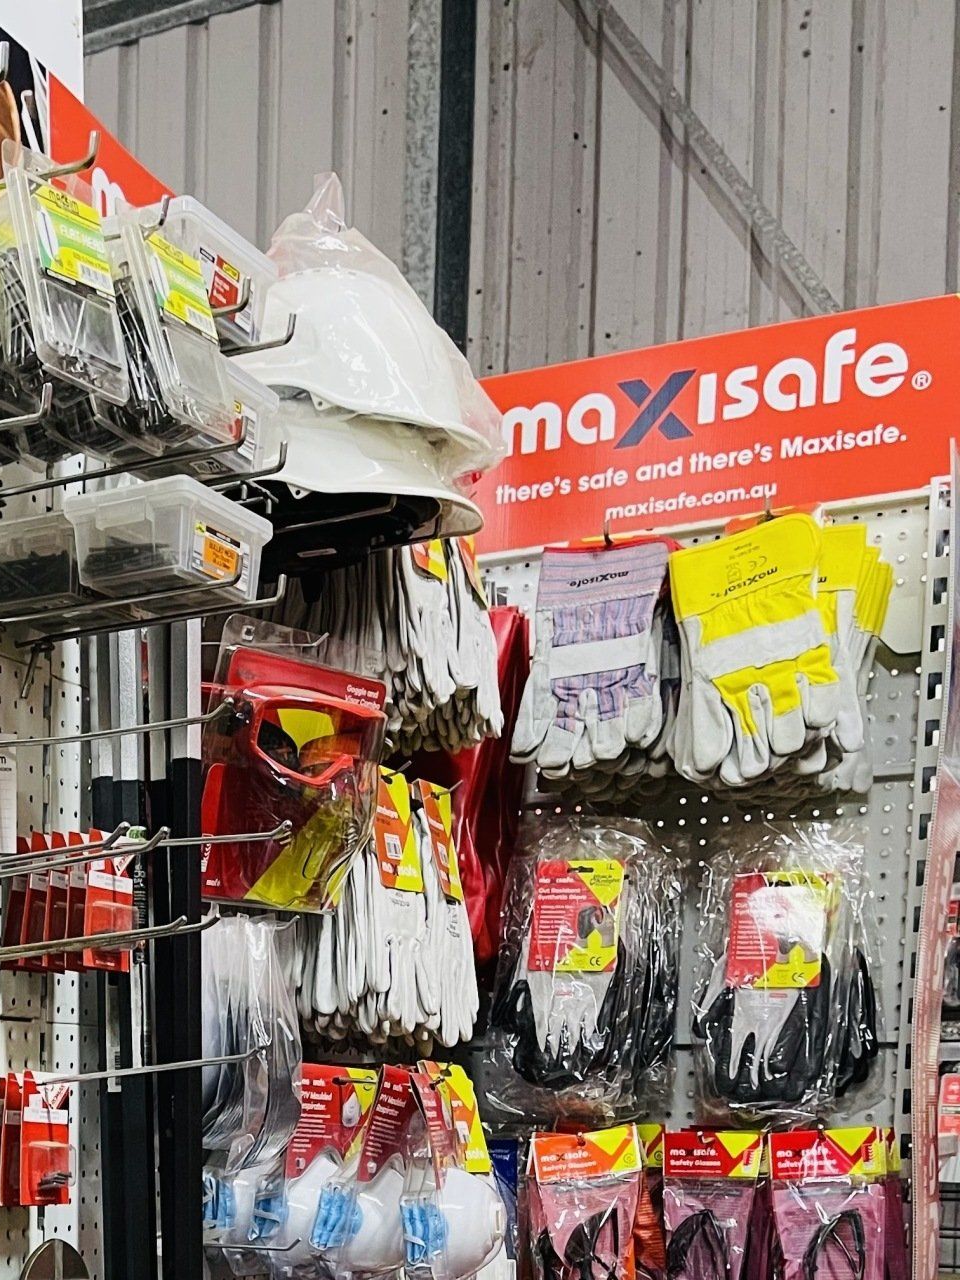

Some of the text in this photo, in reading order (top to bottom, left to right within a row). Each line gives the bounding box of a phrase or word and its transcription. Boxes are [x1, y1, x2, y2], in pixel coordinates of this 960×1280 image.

[577, 466, 628, 492] safe
[636, 457, 683, 482] and
[689, 442, 773, 475] there's
[780, 423, 908, 459] Maxisafe.
[605, 481, 778, 522] maxisafe.com.au
[346, 684, 380, 700] Goggle and
[669, 1159, 721, 1168] Safety Glasses
